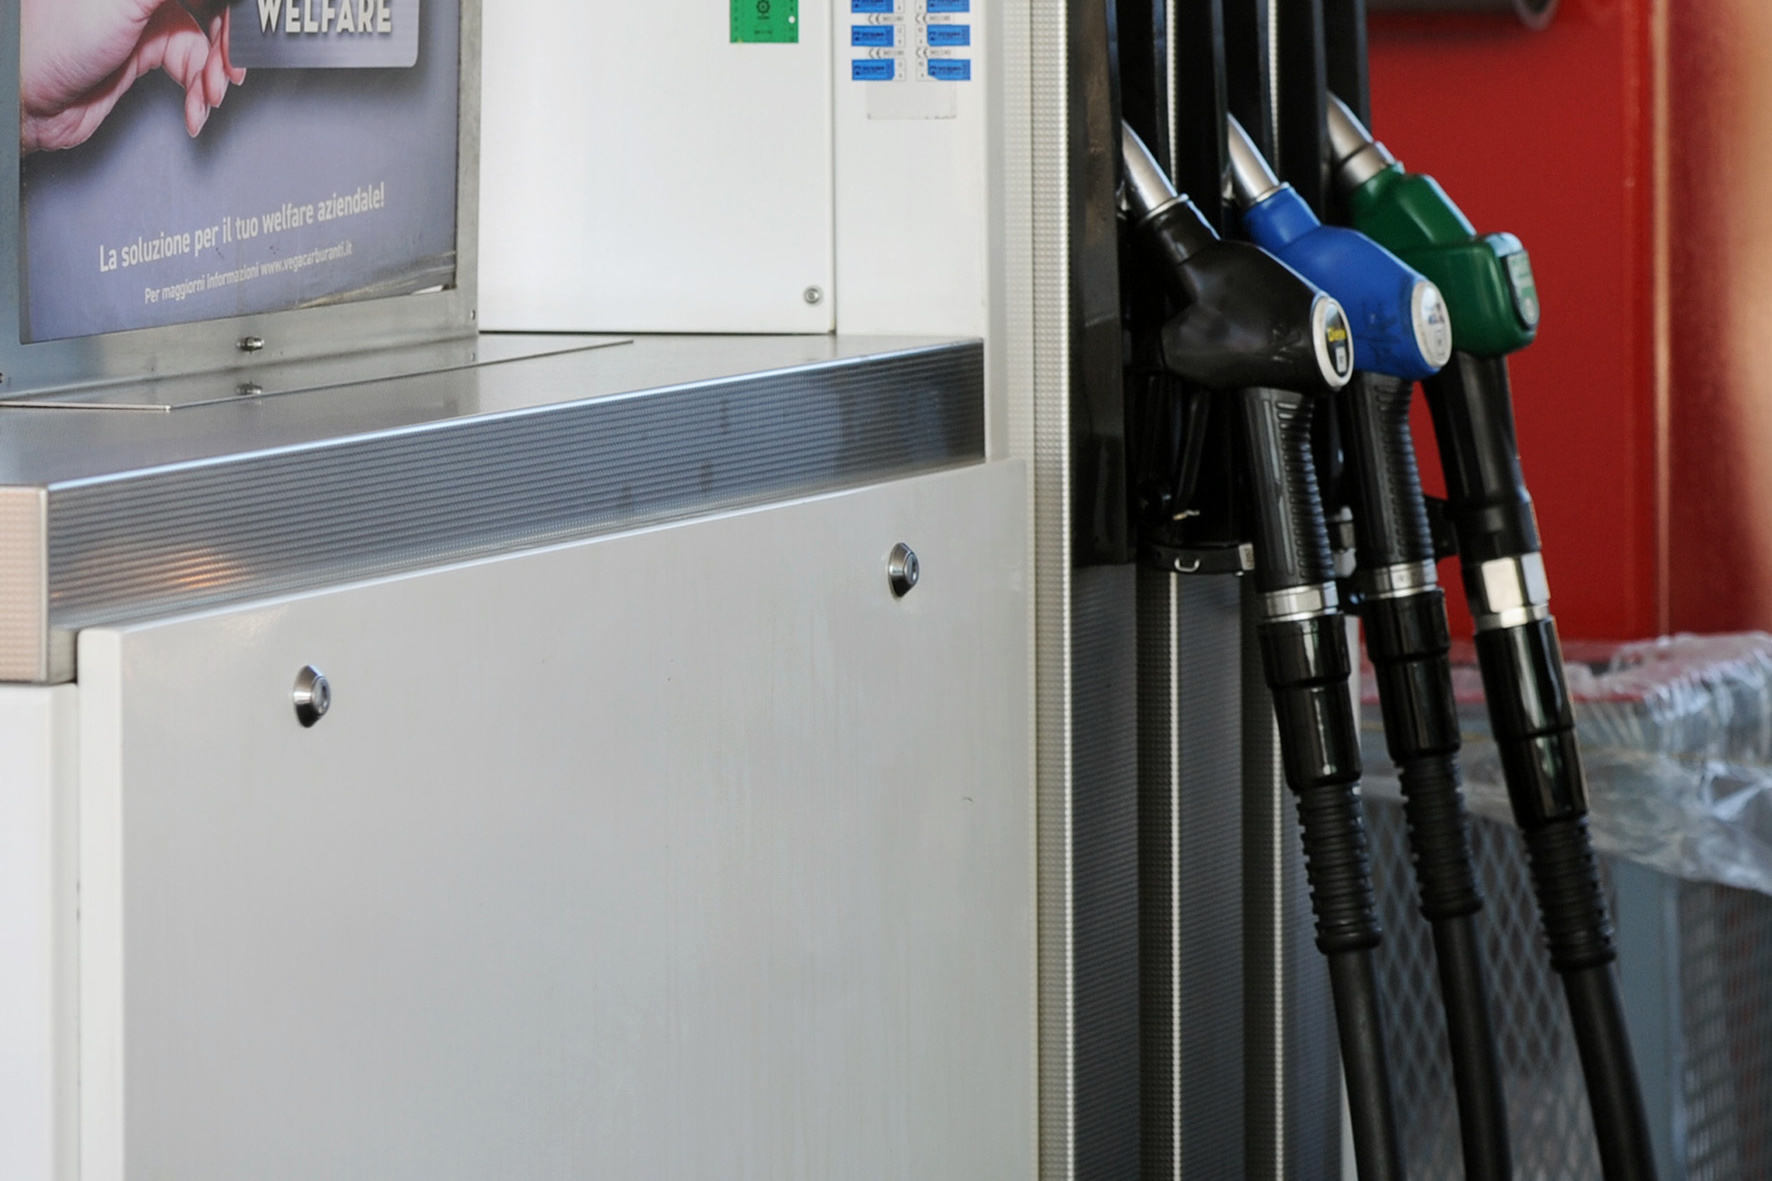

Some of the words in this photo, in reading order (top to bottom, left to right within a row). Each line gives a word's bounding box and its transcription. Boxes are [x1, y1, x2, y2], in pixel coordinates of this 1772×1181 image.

[99, 244, 117, 272] La
[121, 232, 190, 267] soluzione
[194, 226, 219, 257] per
[222, 217, 232, 244] il
[235, 216, 259, 240] tuo
[262, 199, 314, 235] welfare
[317, 181, 386, 222] aziendale!
[144, 287, 160, 304] Per
[206, 261, 259, 290] informazioni
[260, 240, 353, 275] www.vegacarburanti.it
